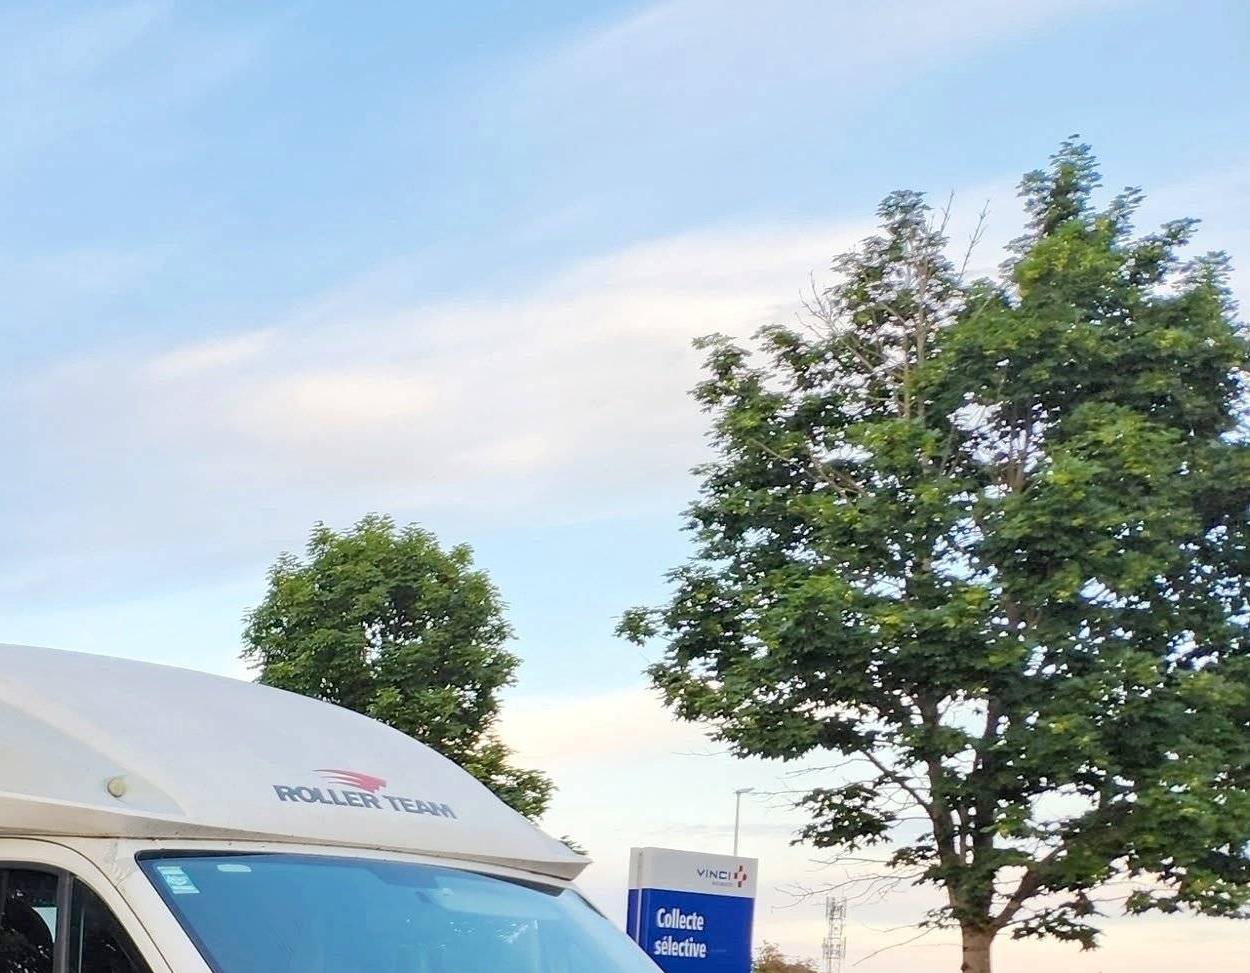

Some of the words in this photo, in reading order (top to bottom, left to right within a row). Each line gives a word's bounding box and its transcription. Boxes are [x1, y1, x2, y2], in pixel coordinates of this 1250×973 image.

[272, 784, 383, 809] ROLLER
[382, 794, 458, 819] TEAM
[696, 868, 731, 880] VINCI
[656, 907, 704, 930] Collecte
[653, 935, 707, 959] sélective
